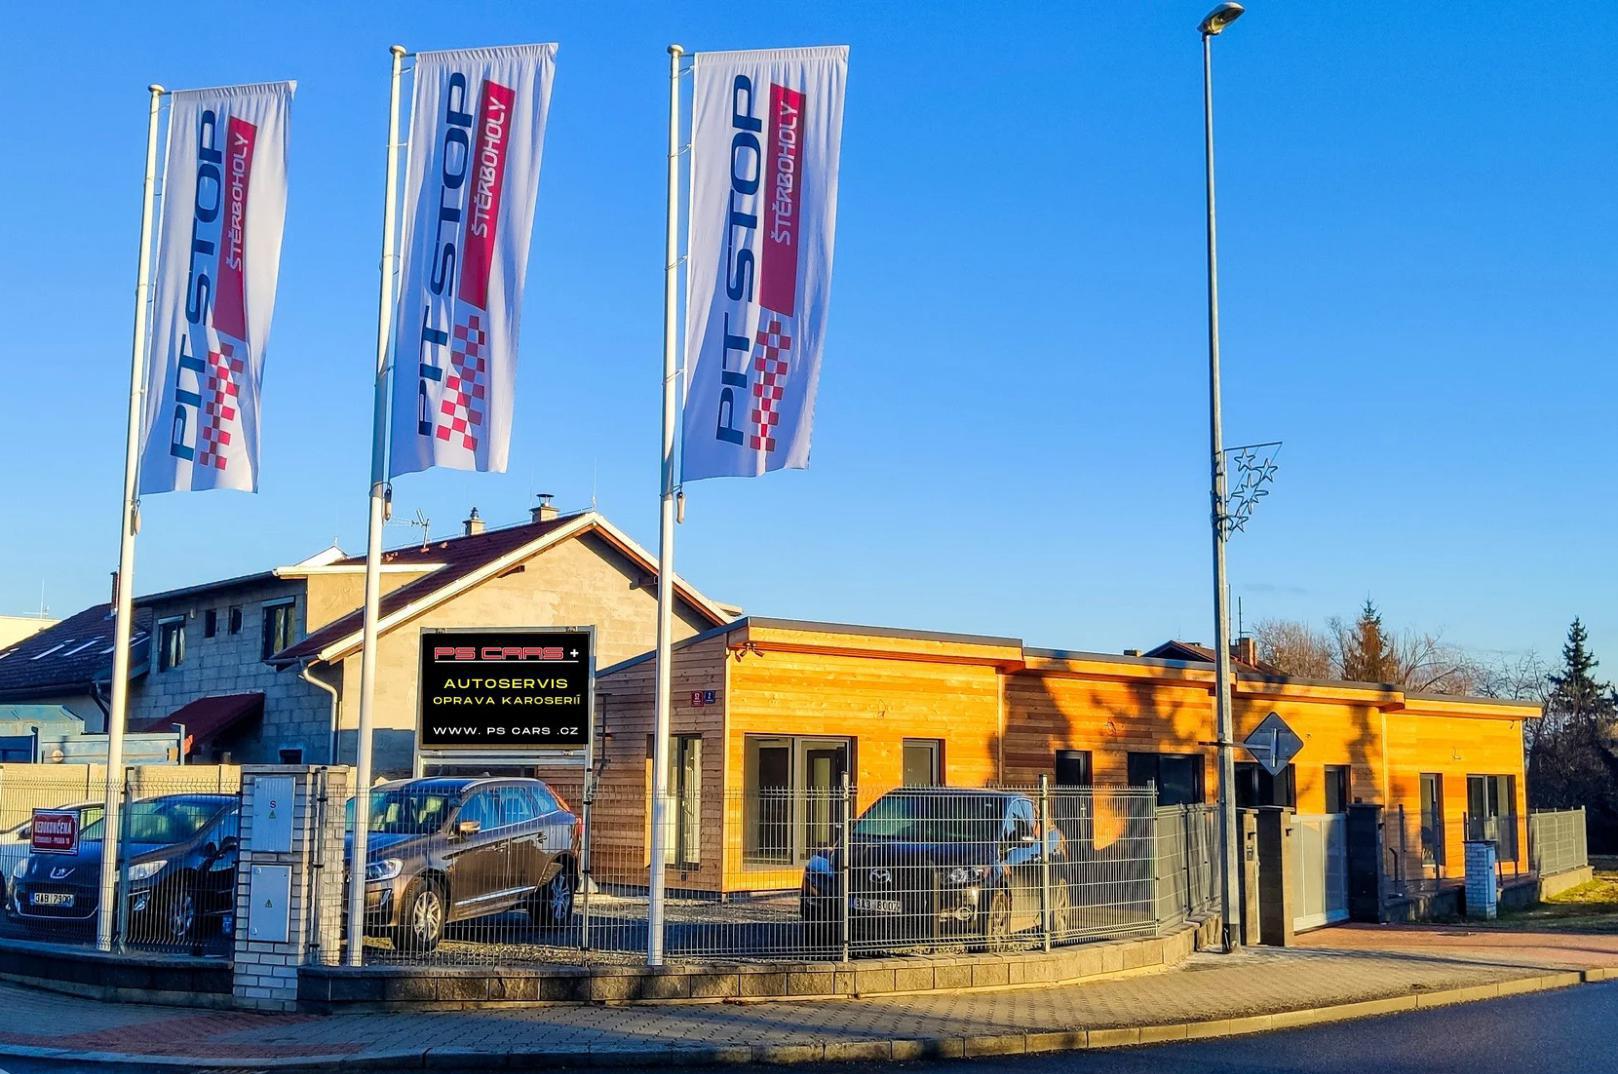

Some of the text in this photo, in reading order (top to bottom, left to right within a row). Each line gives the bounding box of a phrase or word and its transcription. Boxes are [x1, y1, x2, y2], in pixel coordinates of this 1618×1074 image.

[225, 132, 249, 273] ŠTĚRBOHOLY
[472, 95, 506, 238] ŠTĚRBOHOLY
[769, 100, 798, 246] ŠTĚRBOHOLY
[170, 109, 222, 462] PIT STOP
[418, 72, 473, 437] PIT STOP
[716, 74, 762, 446] PIT STOP
[433, 697, 495, 705] OPRAVA
[434, 647, 476, 660] PS
[481, 647, 564, 660] CARS
[444, 678, 568, 689] AUTOSERVIS
